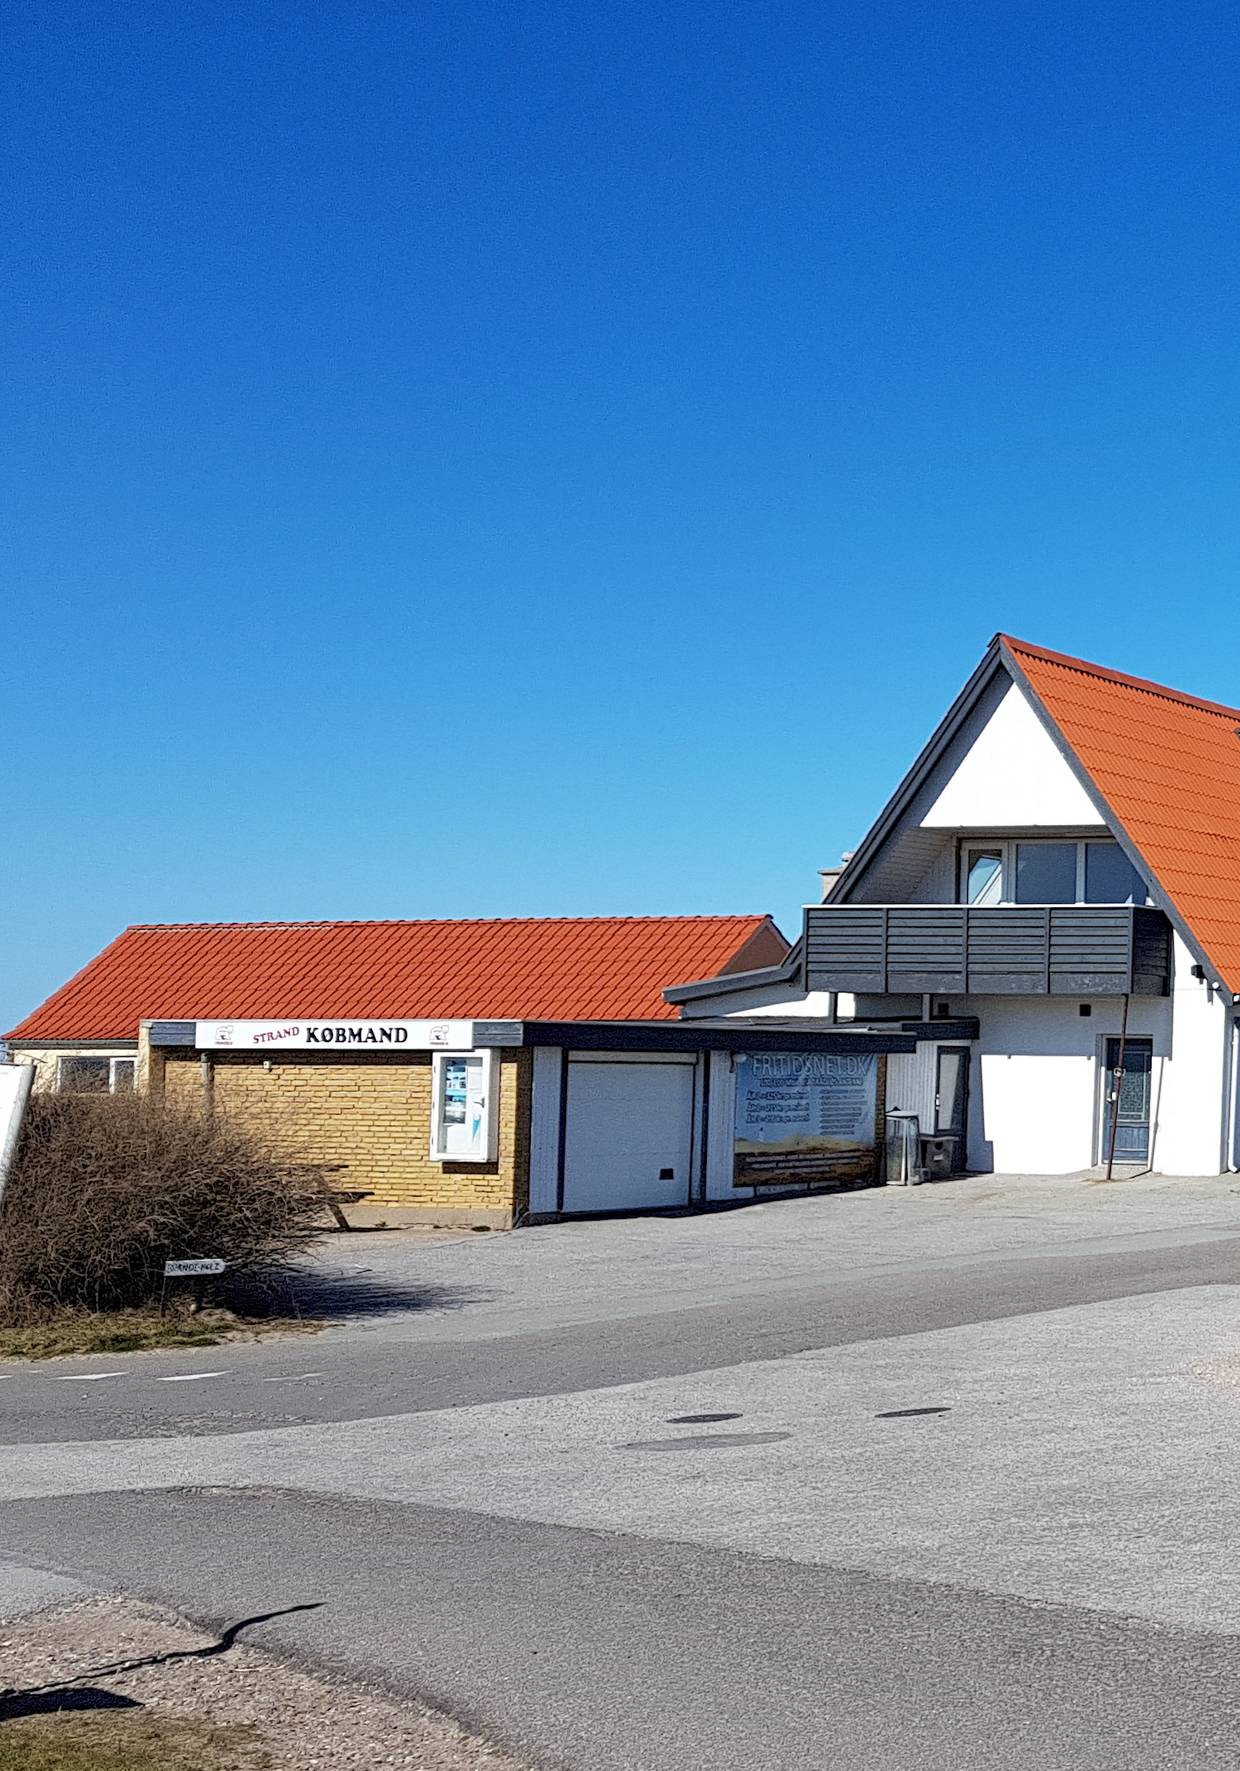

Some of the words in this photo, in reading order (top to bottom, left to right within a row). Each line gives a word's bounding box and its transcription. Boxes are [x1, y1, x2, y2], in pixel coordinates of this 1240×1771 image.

[253, 1026, 300, 1044] STRAND
[305, 1027, 409, 1044] KØBMAND
[752, 1055, 868, 1076] FRITIDSNET.DK
